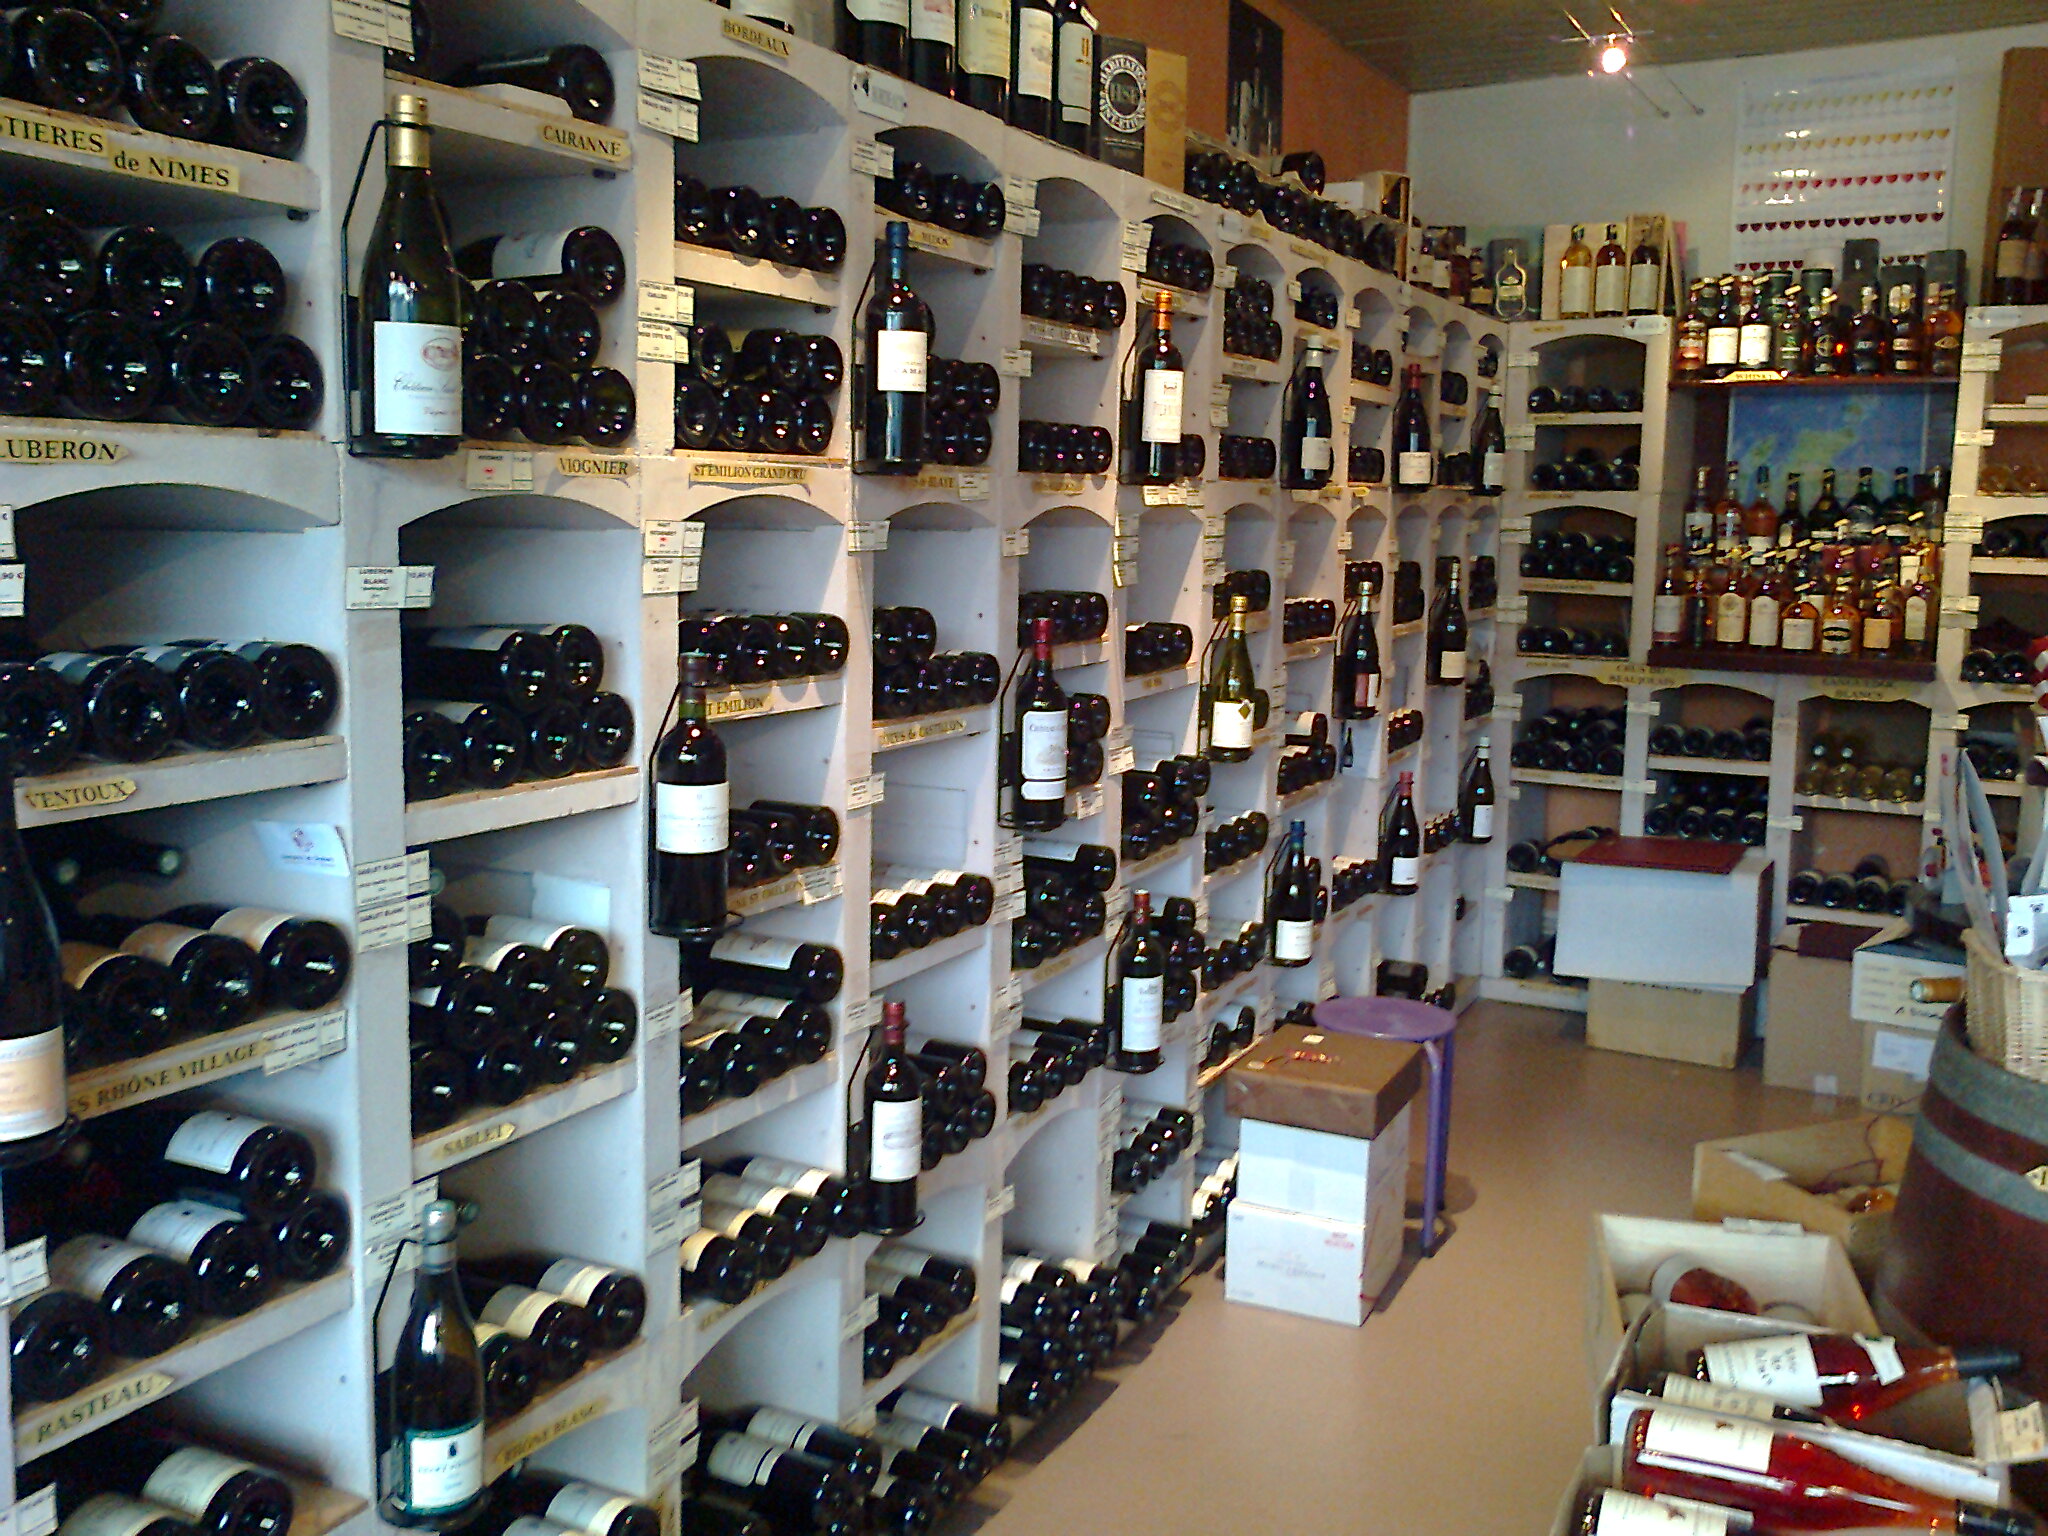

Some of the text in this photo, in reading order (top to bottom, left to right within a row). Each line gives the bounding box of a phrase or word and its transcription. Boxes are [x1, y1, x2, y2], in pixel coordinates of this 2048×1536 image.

[723, 18, 790, 56] BORDEAUX
[0, 116, 104, 153] TIERES
[114, 150, 140, 172] de
[543, 125, 622, 156] CAIRANNE
[0, 439, 119, 460] UBERON
[559, 457, 629, 475] VIOGNIER
[25, 780, 127, 808] VENTOUX
[38, 1374, 156, 1443] RASTEAU
